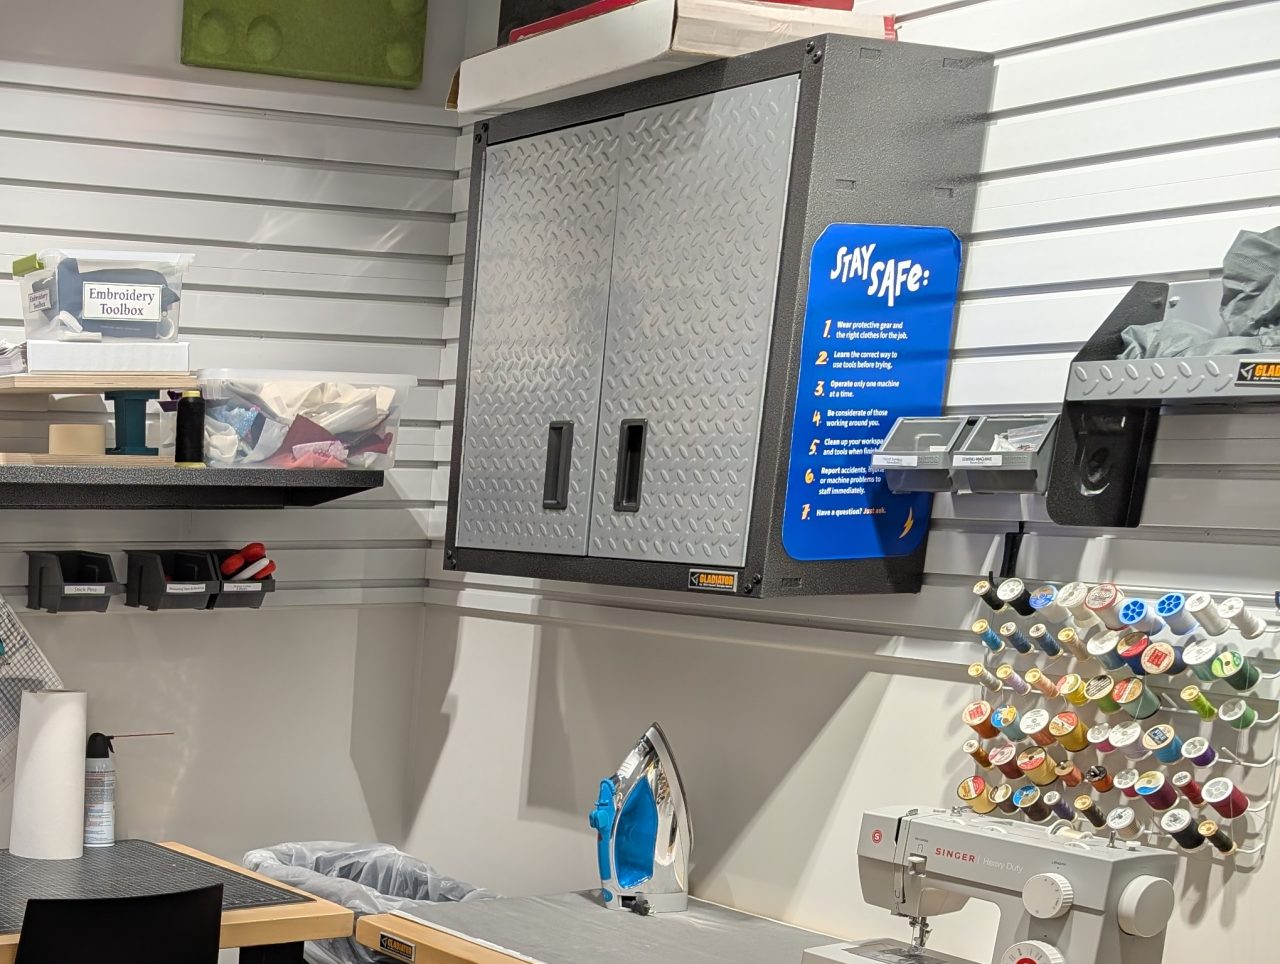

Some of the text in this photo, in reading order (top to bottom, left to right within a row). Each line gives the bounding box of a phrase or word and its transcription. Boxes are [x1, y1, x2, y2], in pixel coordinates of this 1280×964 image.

[830, 243, 876, 283] STAY
[29, 293, 49, 302] Embroidery
[89, 288, 155, 305] Embroidery
[100, 304, 143, 315] Toolbox
[823, 319, 903, 338] 1. Wear protective gear and
[846, 331, 859, 340] right
[897, 332, 908, 340] job.
[815, 351, 829, 365] 2.
[1255, 365, 1280, 376] GLAD
[814, 381, 824, 396] 3.
[830, 380, 853, 388] Operate
[854, 380, 866, 388] only
[812, 410, 821, 426] 4.
[826, 419, 848, 428] working
[809, 439, 820, 455] 5.
[862, 438, 884, 446] workspa
[805, 469, 815, 484] 6.
[821, 467, 840, 475] Report
[841, 466, 867, 474] accidents,
[850, 476, 874, 484] problems
[819, 487, 865, 495] staff immediately.
[836, 508, 862, 517] question?
[700, 574, 733, 585] GLADIATOR
[936, 847, 1023, 873] SINGER Heavy Duty
